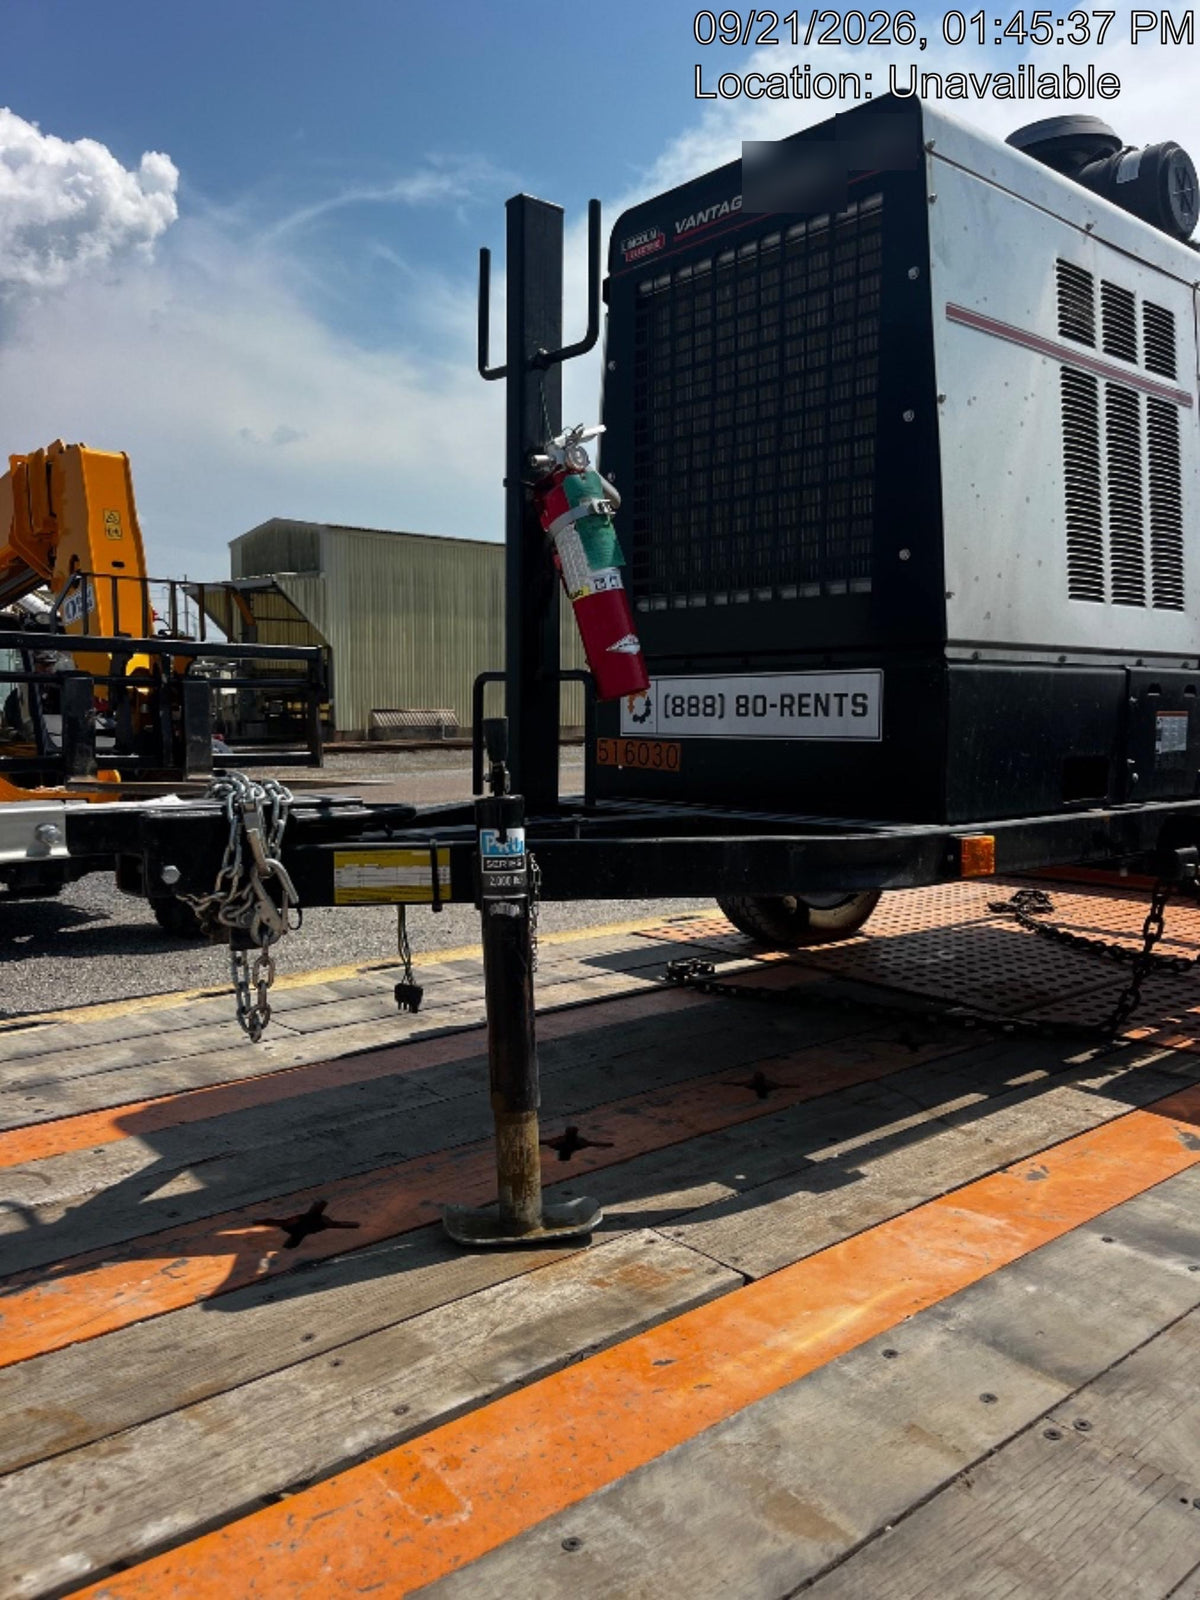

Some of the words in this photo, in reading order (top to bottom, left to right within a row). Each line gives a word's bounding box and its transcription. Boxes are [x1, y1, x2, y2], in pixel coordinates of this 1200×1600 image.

[674, 195, 743, 234] VANTAG
[664, 693, 725, 719] (888)
[735, 692, 869, 718] 80-RENTS
[598, 740, 679, 769] 516030
